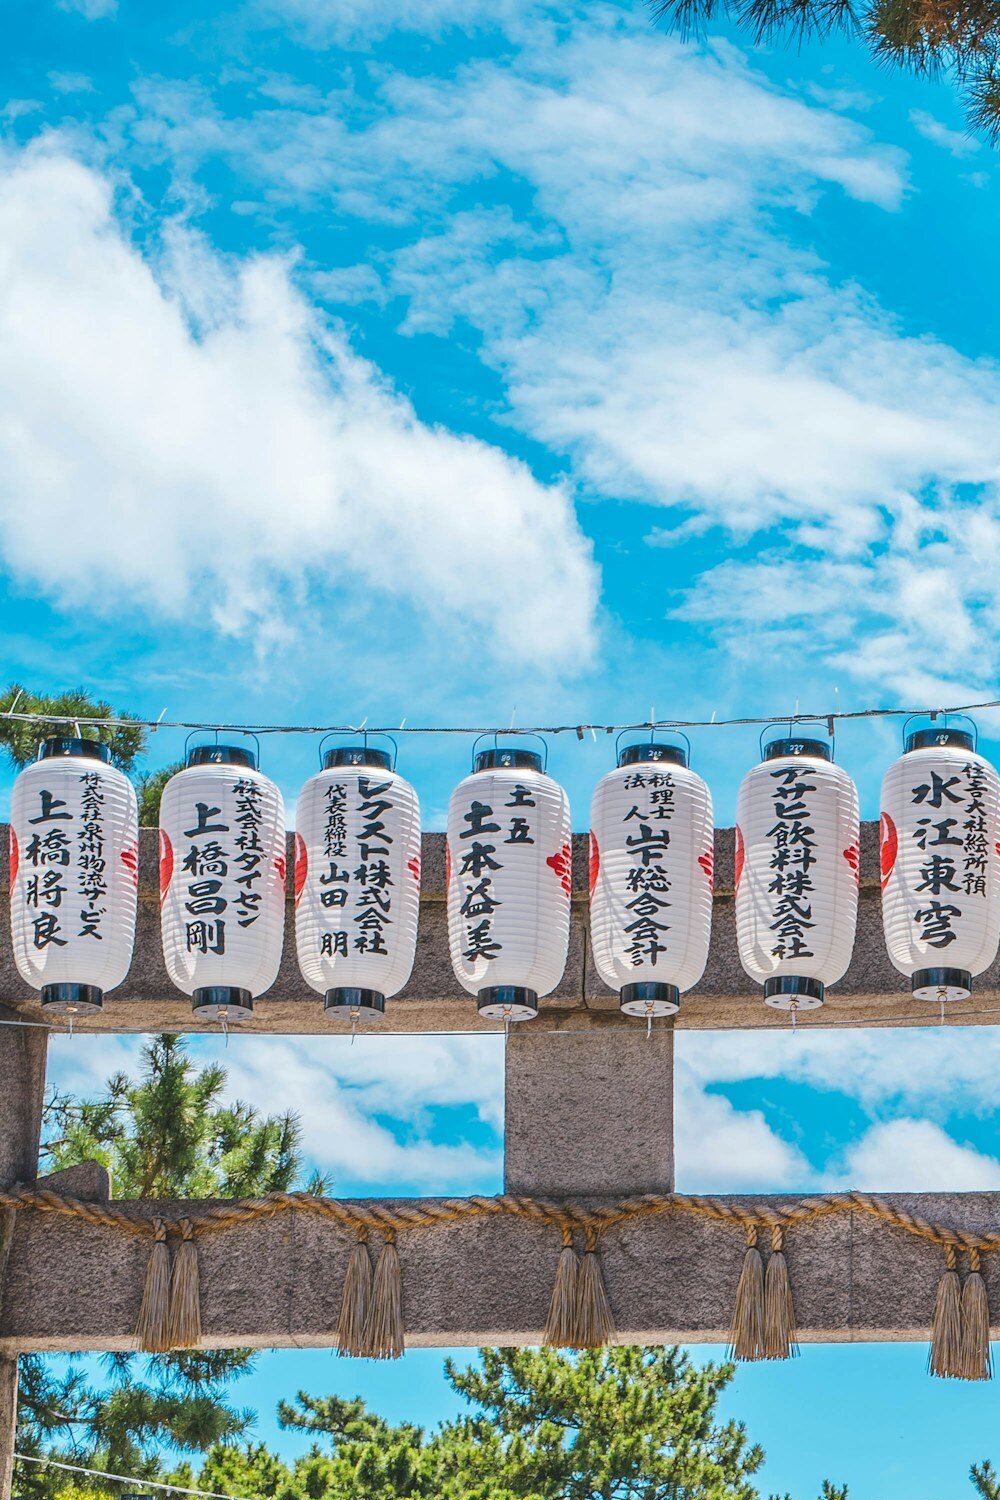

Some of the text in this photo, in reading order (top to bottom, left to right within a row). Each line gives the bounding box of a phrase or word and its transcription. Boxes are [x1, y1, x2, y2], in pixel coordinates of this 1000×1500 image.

[77, 771, 107, 940] 株式会社泉州物流サービス
[181, 802, 230, 956] 上橋昌剛
[231, 778, 266, 929] 株式会社ダイセン
[352, 776, 395, 956] レクスト株式会社
[458, 800, 504, 962] 土本益美
[503, 784, 536, 845] 土五
[764, 767, 818, 961] アサヒ飲料株式会社
[960, 761, 988, 898] 住吉大社絵所預
